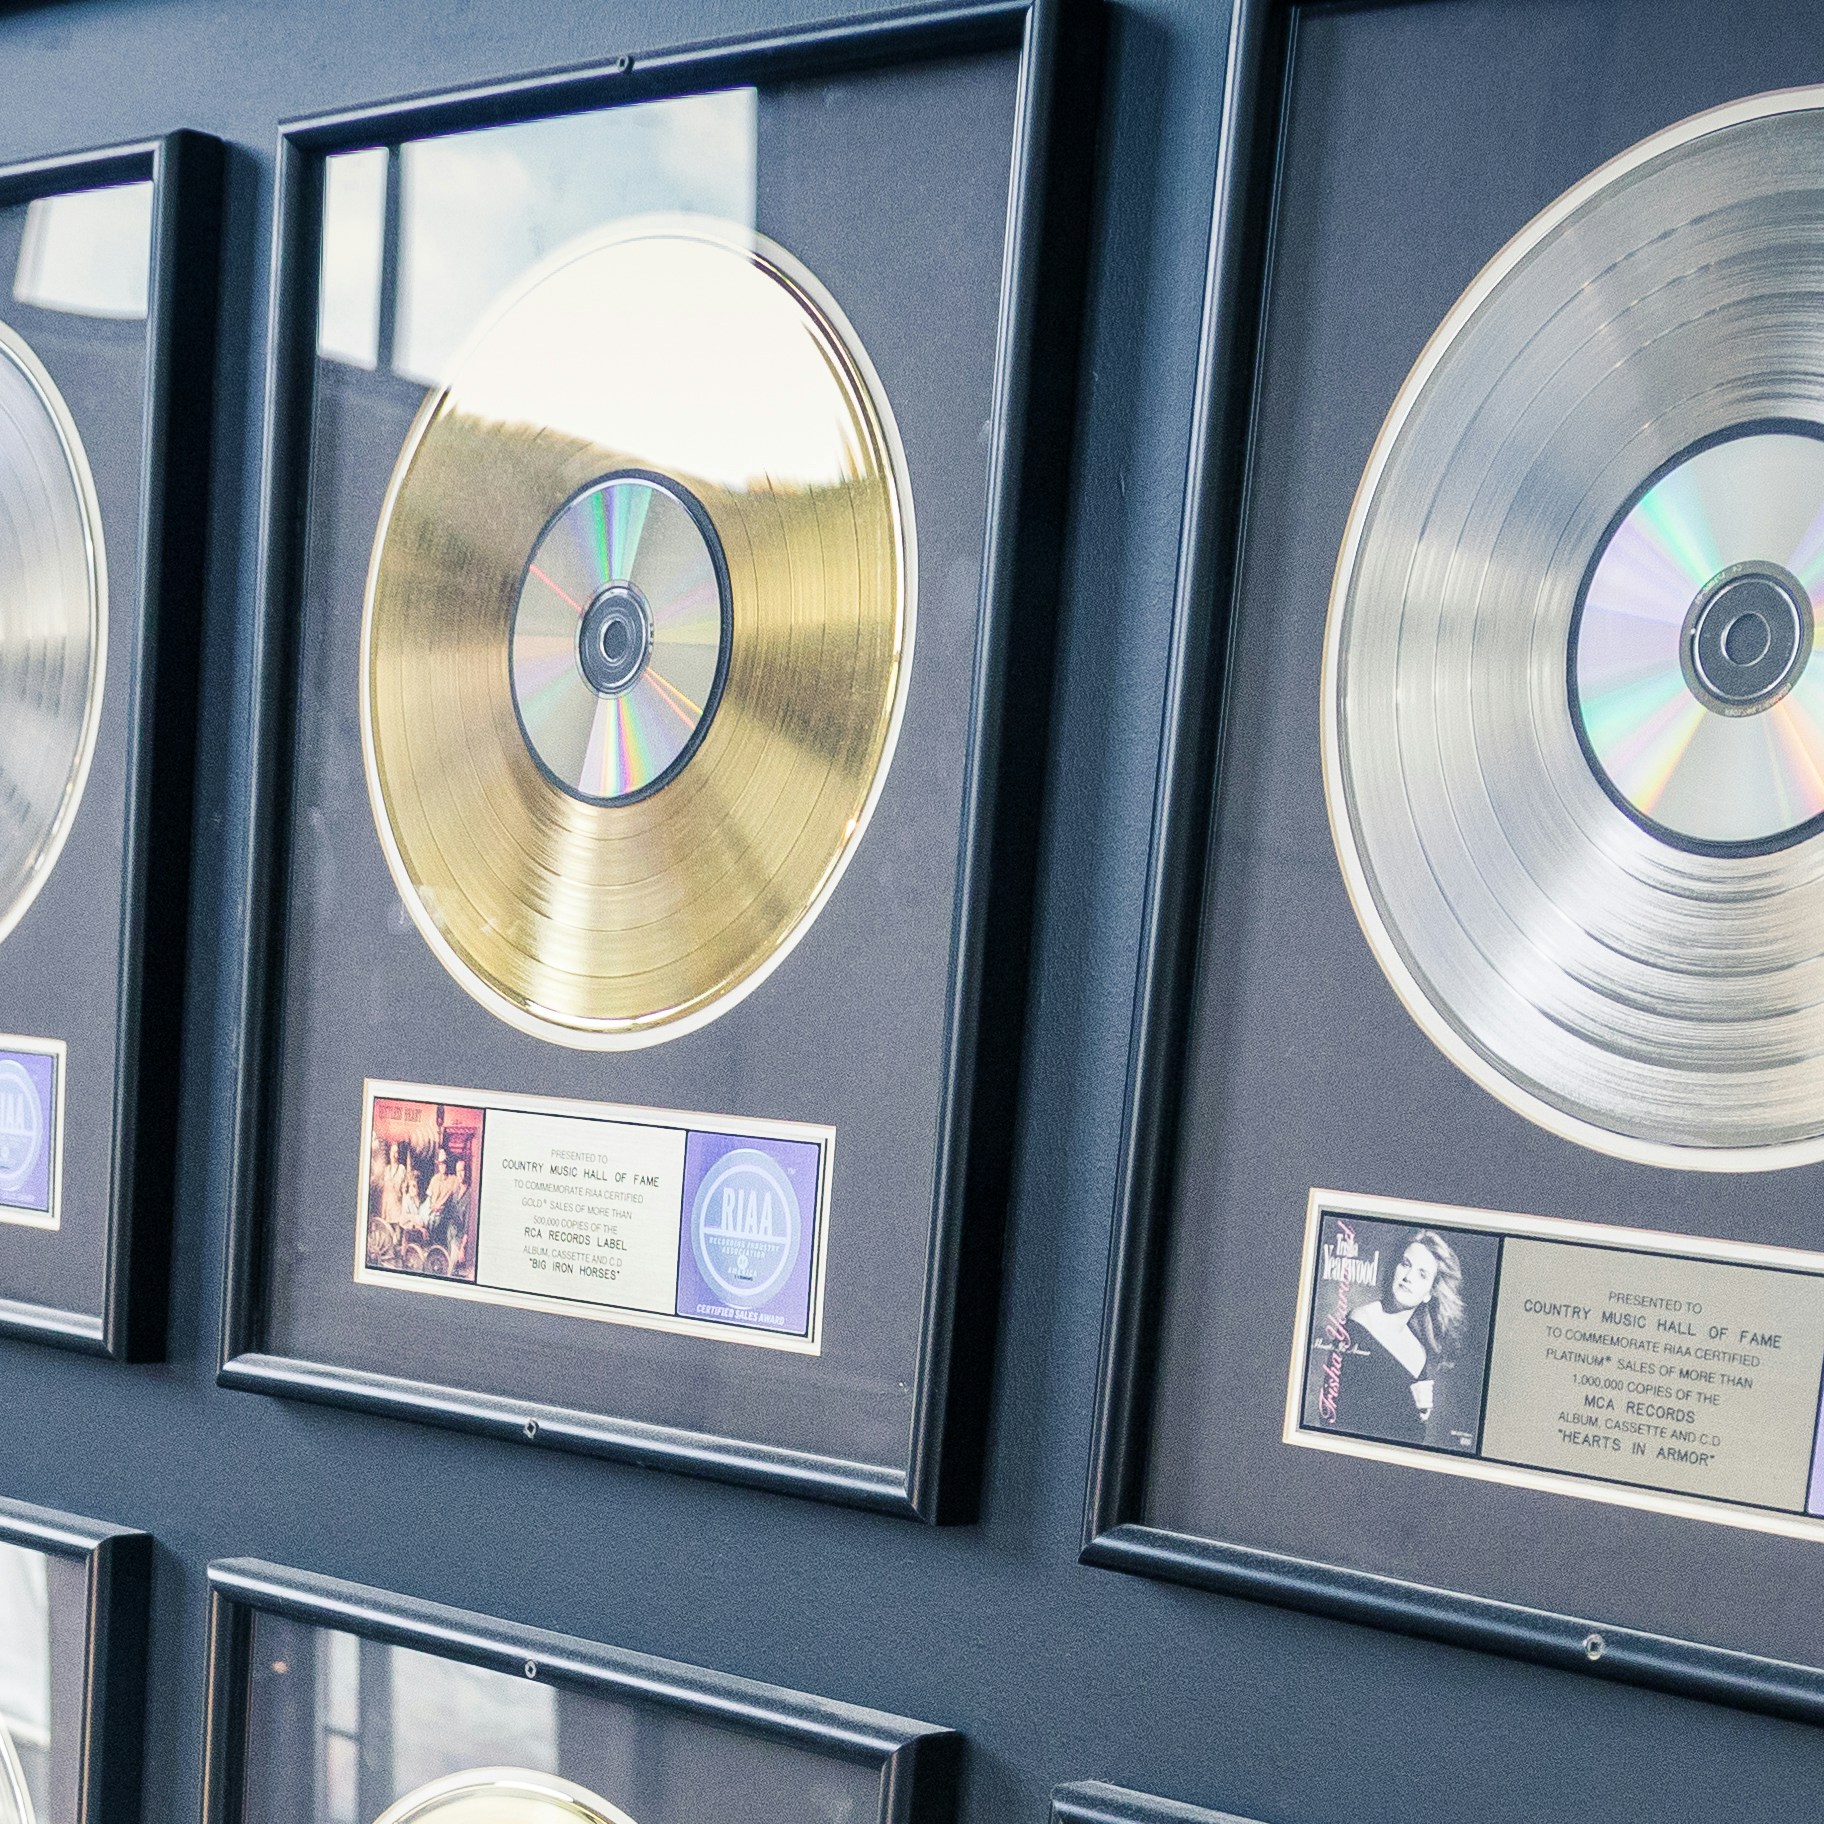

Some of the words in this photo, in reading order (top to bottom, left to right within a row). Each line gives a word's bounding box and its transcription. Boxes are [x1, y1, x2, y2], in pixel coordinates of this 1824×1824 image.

[550, 1148, 596, 1163] PRESENTED
[597, 1154, 608, 1164] TO
[501, 1158, 543, 1174] COUNTRY
[549, 1164, 577, 1178] MUSIC
[583, 1167, 608, 1181] HALL
[614, 1171, 626, 1184] OF
[633, 1173, 659, 1188] FAME
[513, 1178, 524, 1189] TO
[524, 1180, 583, 1196] COMMEMORATE
[584, 1187, 602, 1199] RIAA
[603, 1190, 643, 1204] CERTIFIED
[549, 1200, 573, 1212] SALES
[574, 1203, 586, 1214] OF
[587, 1204, 609, 1217] MORE
[611, 1208, 632, 1220] THAN
[720, 1185, 775, 1236] RIAA
[523, 1226, 542, 1239] RCA
[548, 1229, 591, 1246] RECORDS
[596, 1236, 627, 1251] LABEL
[560, 1218, 589, 1232] COPIES
[590, 1222, 602, 1233] OF
[602, 1224, 618, 1235] THE
[551, 1249, 590, 1264] CASSETTE
[591, 1254, 607, 1266] AND
[552, 1260, 573, 1274] IRON
[695, 1303, 734, 1318] CERTIFIED
[733, 1308, 758, 1322] SALES
[757, 1312, 785, 1326] AWARD
[1607, 1290, 1682, 1313] PRESENTED
[1683, 1300, 1703, 1315] TO
[1522, 1298, 1592, 1322] COUNTRY
[1600, 1309, 1647, 1330] MUSIC
[1656, 1317, 1698, 1337] HALL
[1707, 1324, 1729, 1341] OF
[1738, 1328, 1782, 1349] FAME
[1545, 1325, 1564, 1340] TO
[1564, 1328, 1661, 1354] COMMEMORATE
[1662, 1342, 1692, 1358] RIAA
[1693, 1346, 1760, 1368] CERTIFIED
[1616, 1357, 1657, 1375] SALES
[1658, 1363, 1678, 1378] OF
[1678, 1366, 1716, 1384] MORE
[1719, 1372, 1754, 1389] THAN
[1626, 1381, 1673, 1400] COPIES
[1674, 1388, 1694, 1403] OF
[1695, 1391, 1721, 1407] THE
[1583, 1393, 1616, 1412] MCA
[1625, 1400, 1696, 1424] RECORDS
[1557, 1410, 1602, 1430] ALBUM,
[1603, 1417, 1668, 1440] CASSETTE
[1669, 1428, 1696, 1445] AND
[1631, 1440, 1646, 1456] IN
